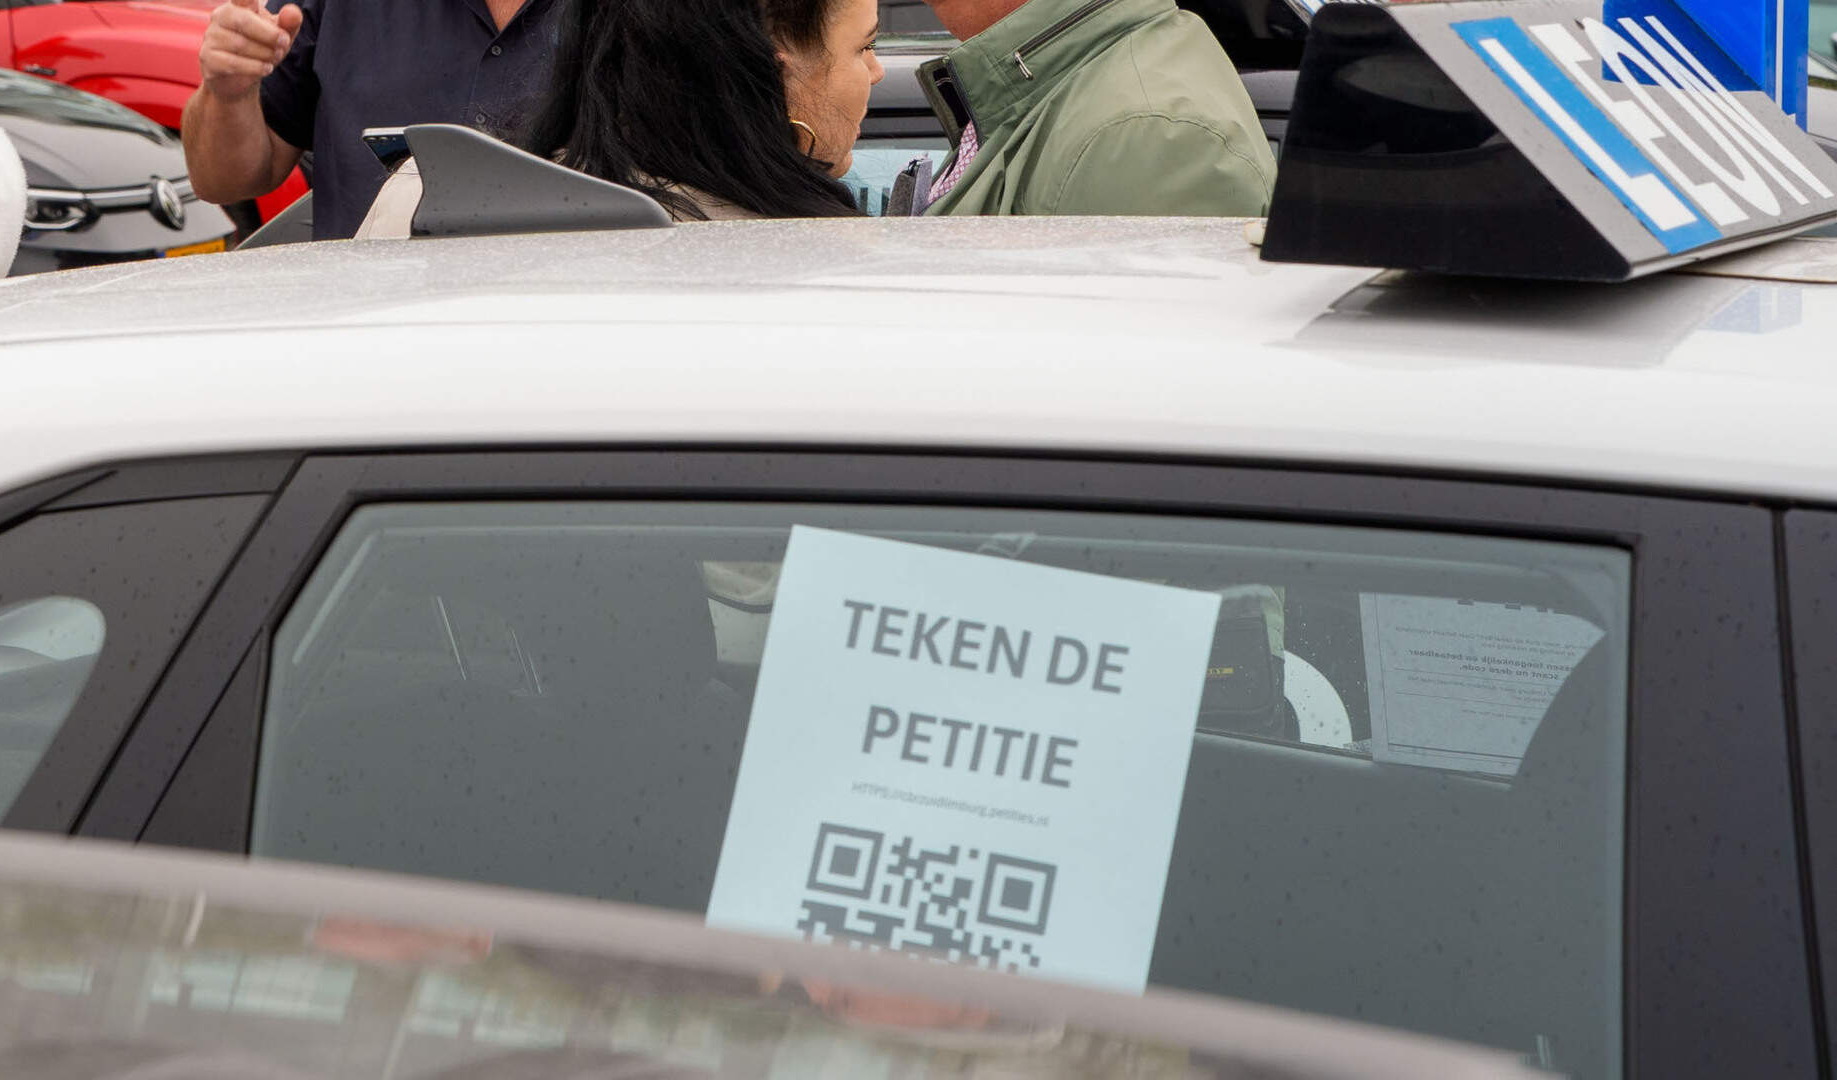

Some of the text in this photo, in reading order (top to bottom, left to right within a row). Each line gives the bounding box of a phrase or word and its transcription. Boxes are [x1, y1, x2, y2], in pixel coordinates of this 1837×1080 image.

[1479, 16, 1835, 232] LEON
[843, 599, 1131, 695] TEKEN DE
[861, 705, 1079, 789] PETITIE
